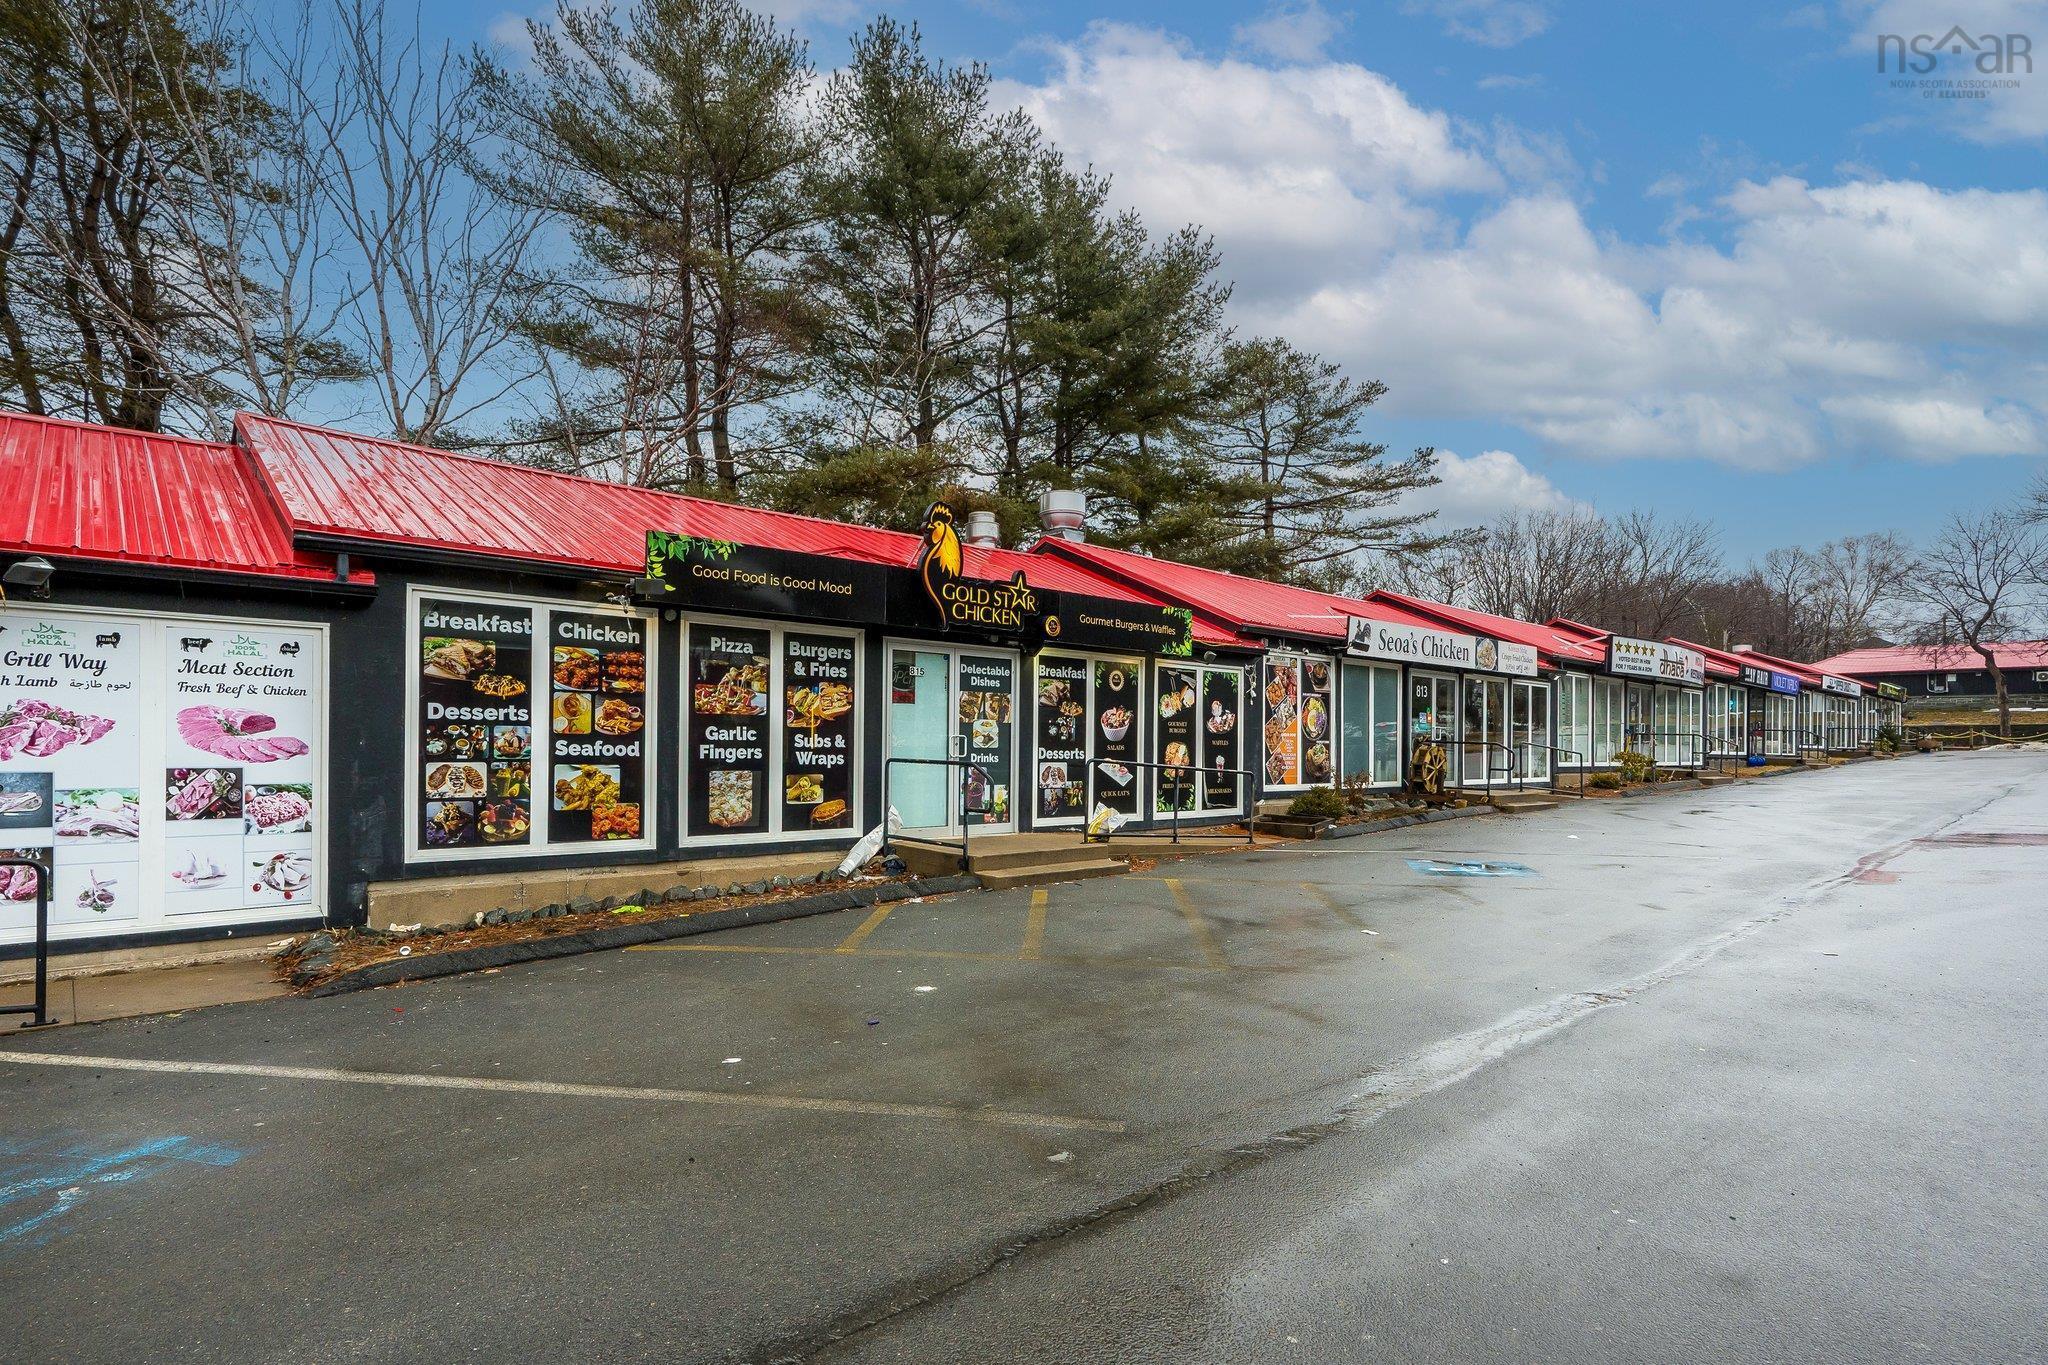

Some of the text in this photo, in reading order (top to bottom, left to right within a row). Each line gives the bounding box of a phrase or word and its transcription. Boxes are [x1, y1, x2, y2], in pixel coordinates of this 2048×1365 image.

[692, 564, 852, 595] Good Food is Good Mood
[942, 583, 990, 605] GOLD
[424, 611, 532, 635] Breakfast
[952, 602, 1021, 627] CHICKEN
[558, 622, 640, 644] Chicken
[1079, 614, 1176, 636] Gourmet Burgers & Waffles
[27, 639, 70, 647] HALAL
[710, 636, 754, 655] Pizza
[789, 641, 852, 662] Burgers
[1378, 628, 1470, 662] Seoa's Chicken
[227, 649, 264, 657] HALAL
[4, 650, 108, 677] Grill Way
[178, 658, 295, 678] Meat Section
[793, 661, 848, 679] & Fries
[960, 663, 1011, 677] Delectable
[1039, 665, 1086, 680] Breakfast
[15, 675, 58, 687] Lamb
[177, 681, 307, 699] Fresh Beef & Chicken
[970, 676, 1001, 688] Dishes
[1416, 684, 1428, 697] 813
[427, 702, 529, 721] Desserts
[705, 725, 757, 742] Garlic
[794, 733, 846, 748] Subs &
[554, 739, 640, 757] Seafood
[699, 744, 763, 764] Fingers
[1038, 747, 1085, 760] Desserts
[796, 751, 845, 768] Wraps
[970, 753, 999, 763] Drinks
[1101, 790, 1117, 798] QUICK
